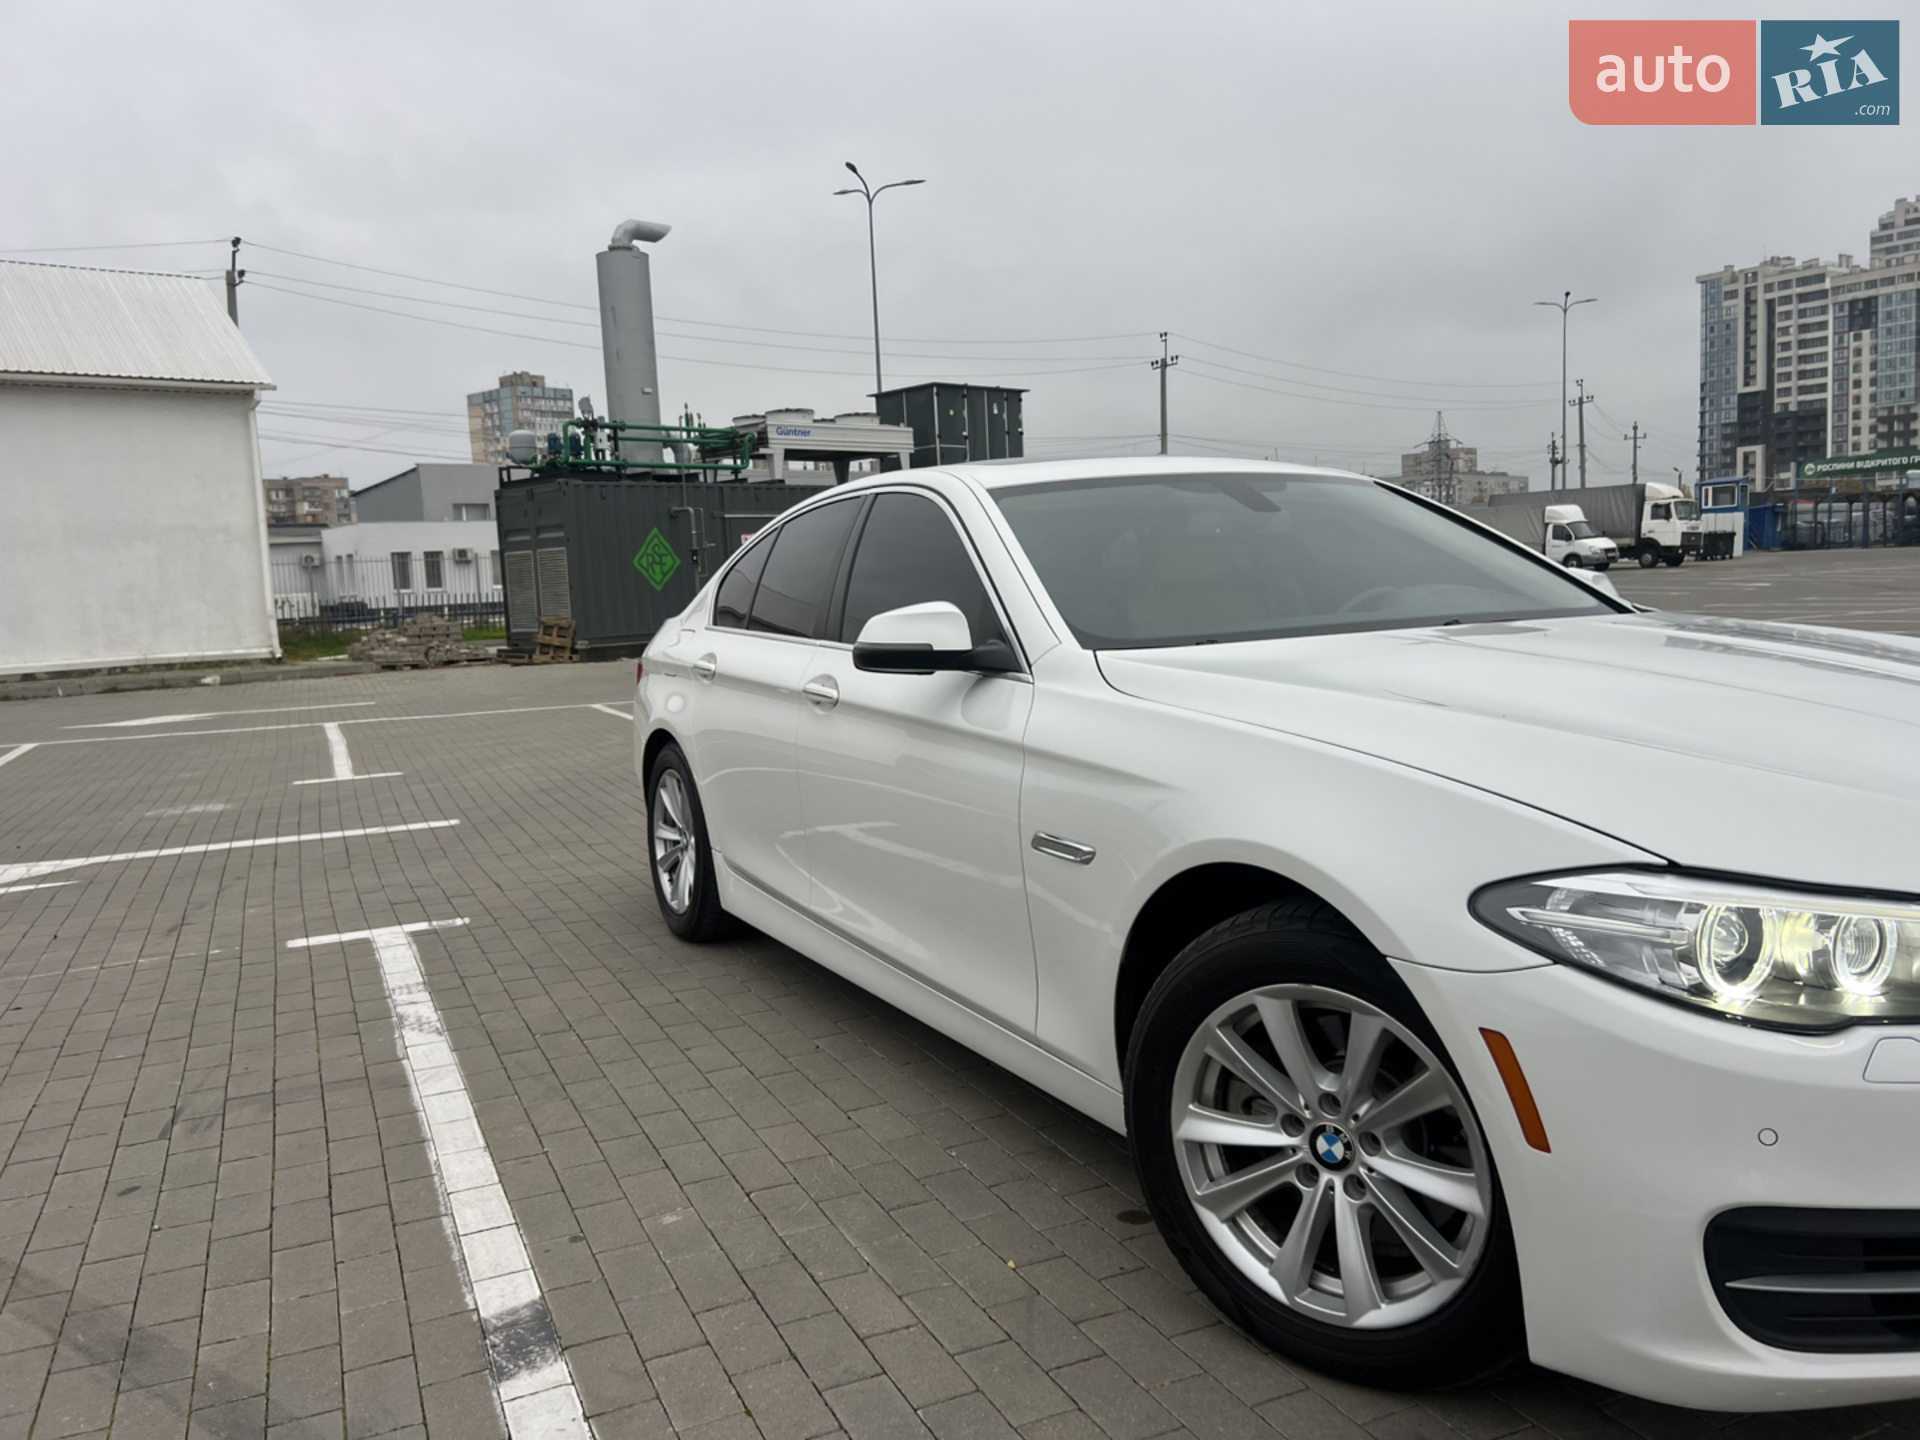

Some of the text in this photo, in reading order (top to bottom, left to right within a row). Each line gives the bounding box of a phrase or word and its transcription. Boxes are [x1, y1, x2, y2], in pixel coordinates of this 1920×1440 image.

[776, 426, 811, 437] Güntner
[1817, 461, 1855, 472] РОСЛИНИ
[1856, 457, 1909, 469] ВІДКРИТОГО
[1325, 1124, 1353, 1160] BMW
